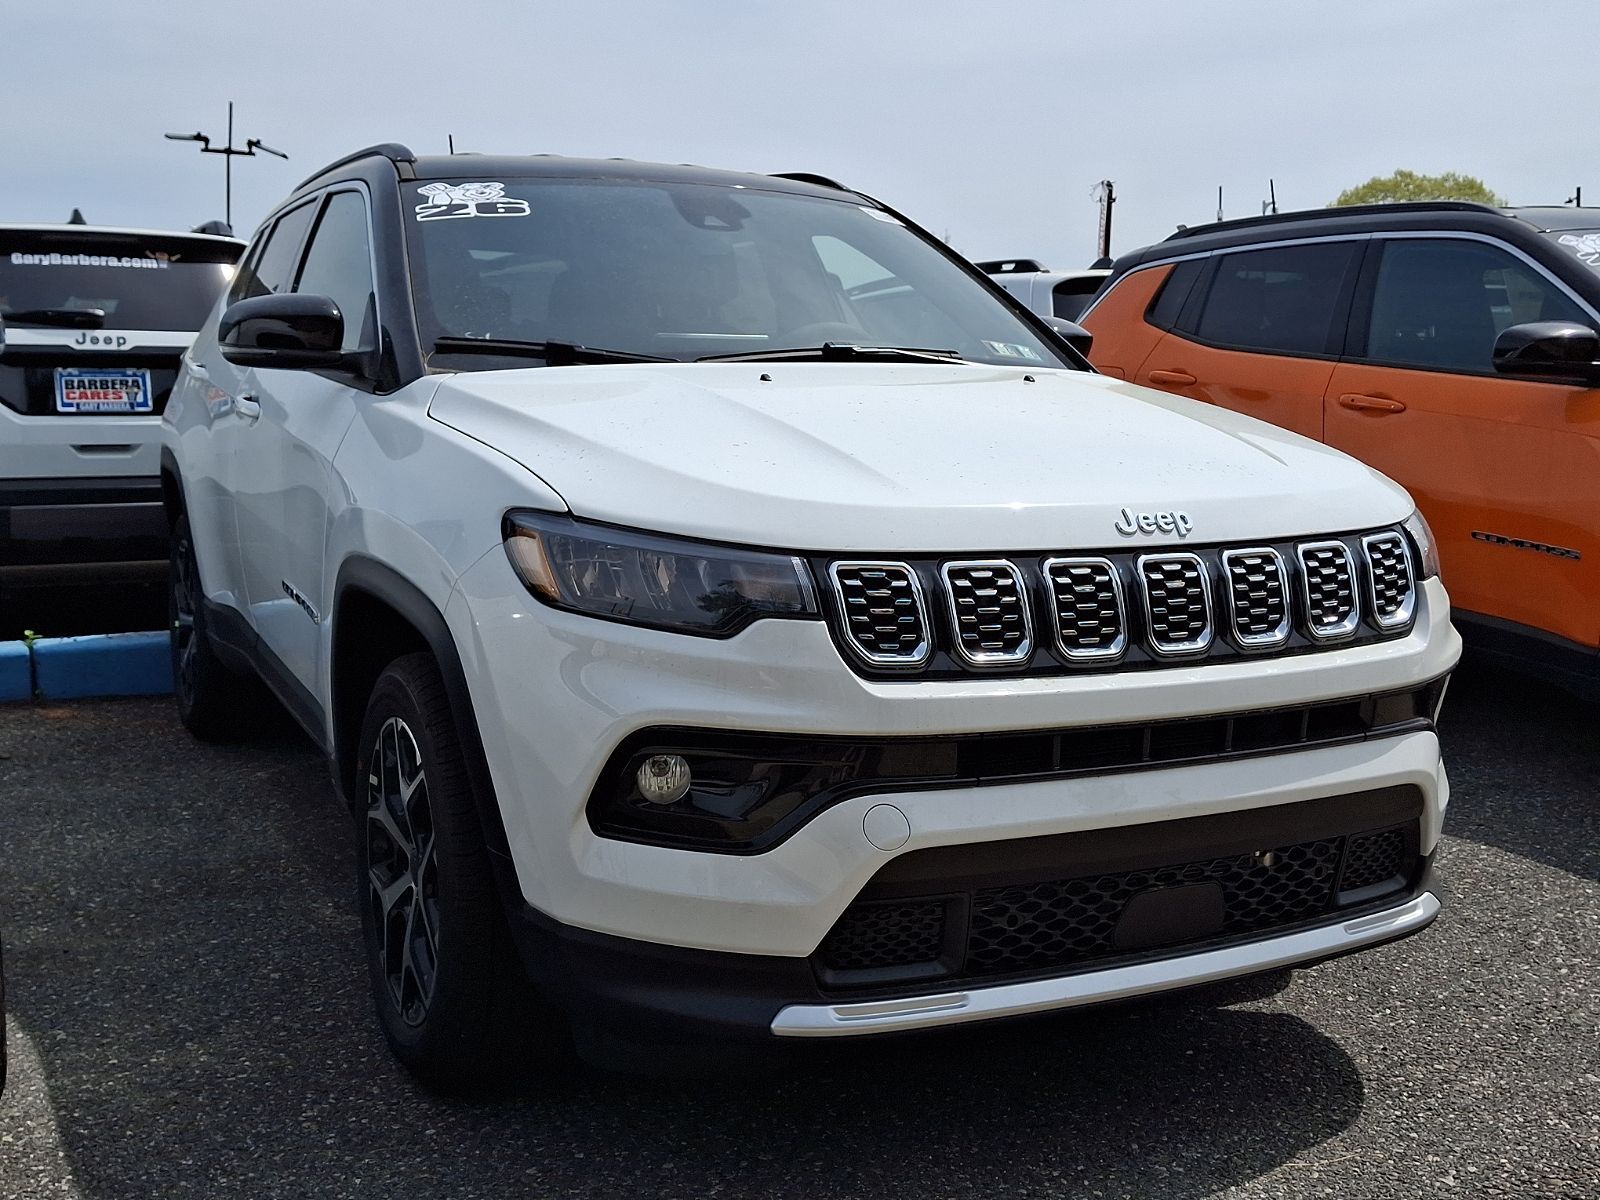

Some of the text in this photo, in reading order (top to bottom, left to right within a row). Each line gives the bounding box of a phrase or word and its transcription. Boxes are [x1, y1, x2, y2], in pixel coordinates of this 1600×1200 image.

[415, 202, 531, 221] 26
[11, 252, 158, 269] GaryBarbera.com
[75, 332, 127, 347] Jeep
[64, 379, 141, 390] BARBERA
[65, 390, 124, 400] CARES
[1115, 507, 1193, 539] Jeep
[1471, 531, 1580, 560] COMPASS
